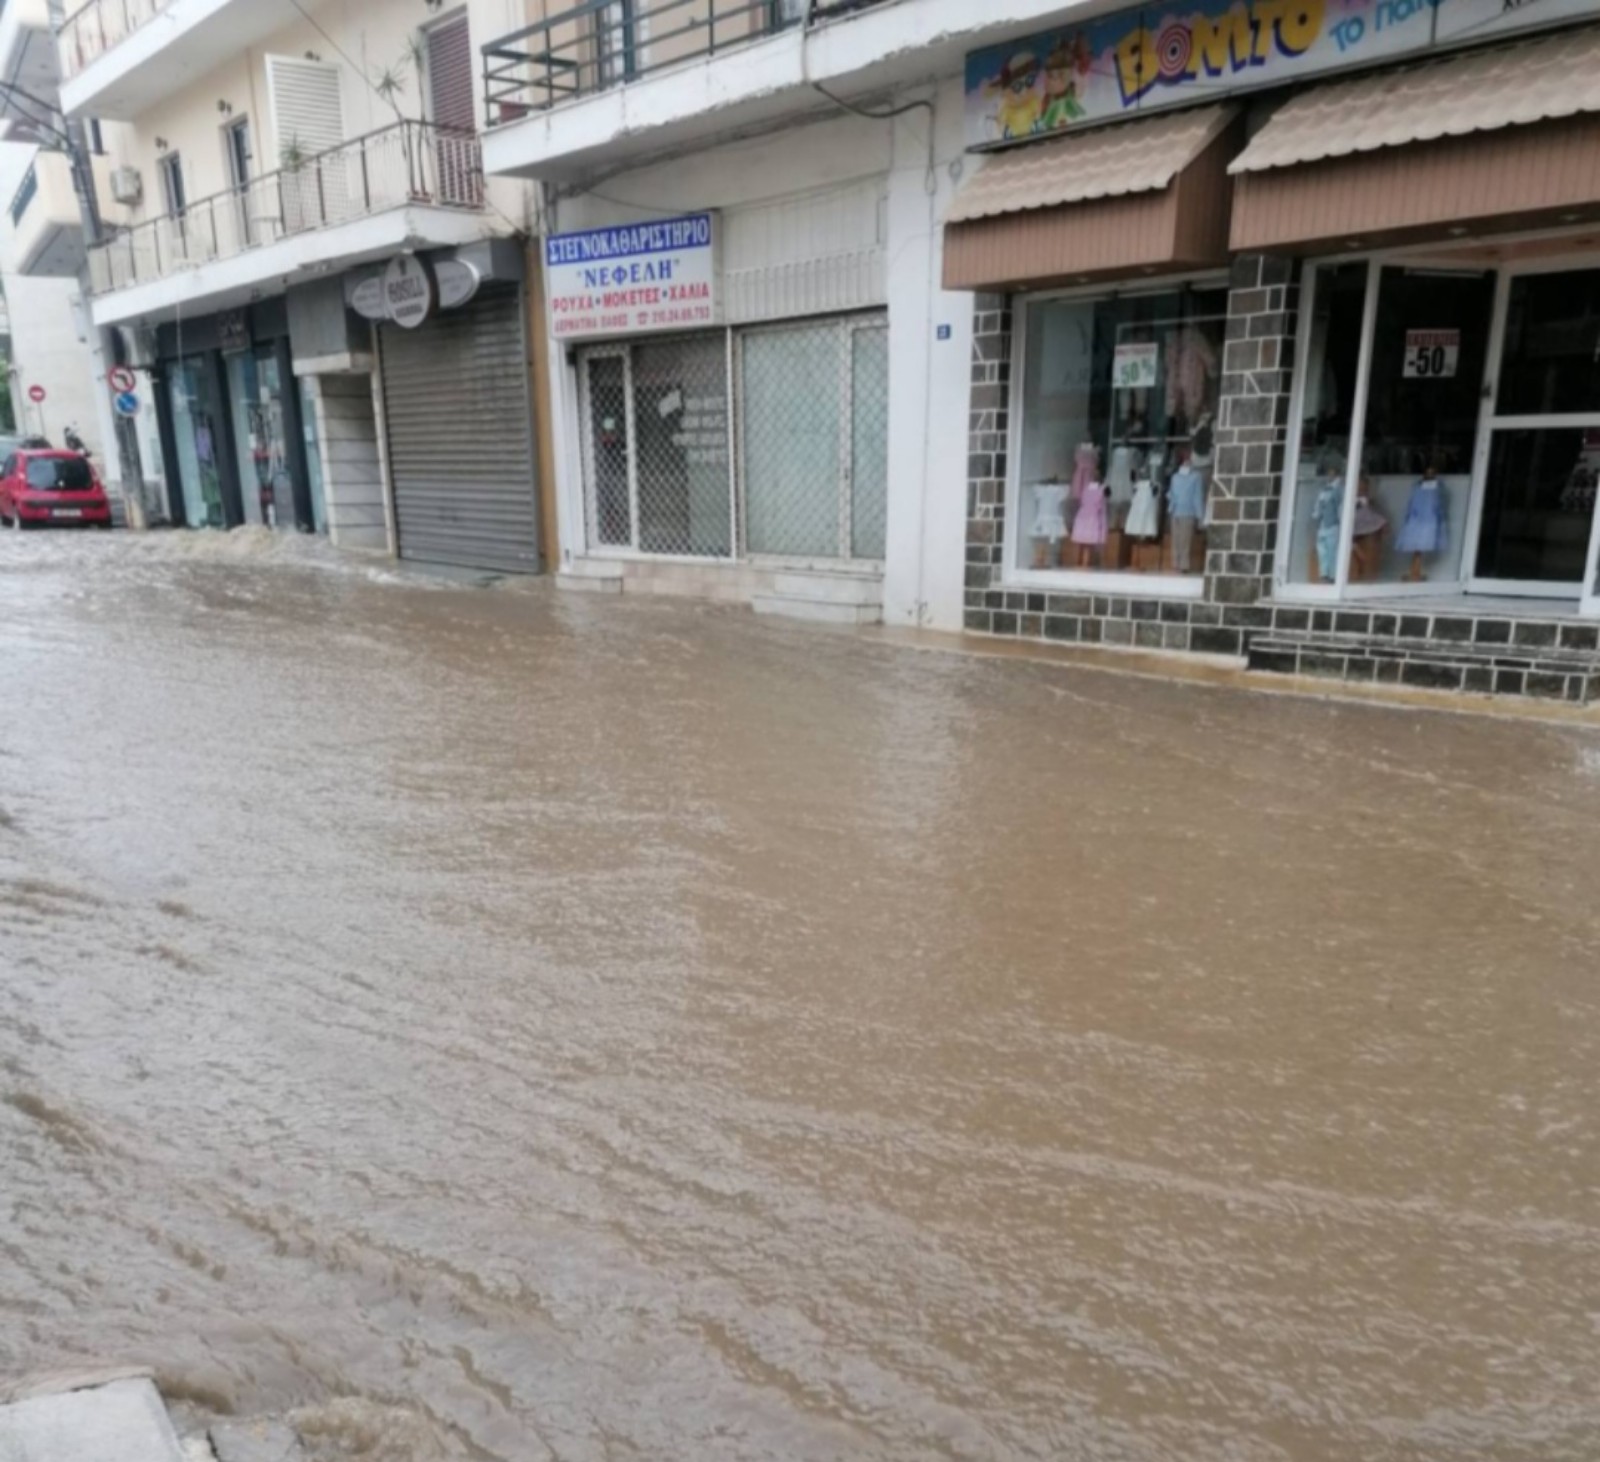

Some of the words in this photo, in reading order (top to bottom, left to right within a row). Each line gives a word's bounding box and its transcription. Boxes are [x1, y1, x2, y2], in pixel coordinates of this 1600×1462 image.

[549, 216, 709, 262] ΣΤΕΓΝΟΚΑΘΑΡΙΣΤΗΡΙΟ
[553, 296, 594, 313] ΡΟΥΧΑ
[602, 288, 661, 306] ΜΟΚΕΤΕΣ
[668, 282, 709, 301] ΧΑΛΙΑ
